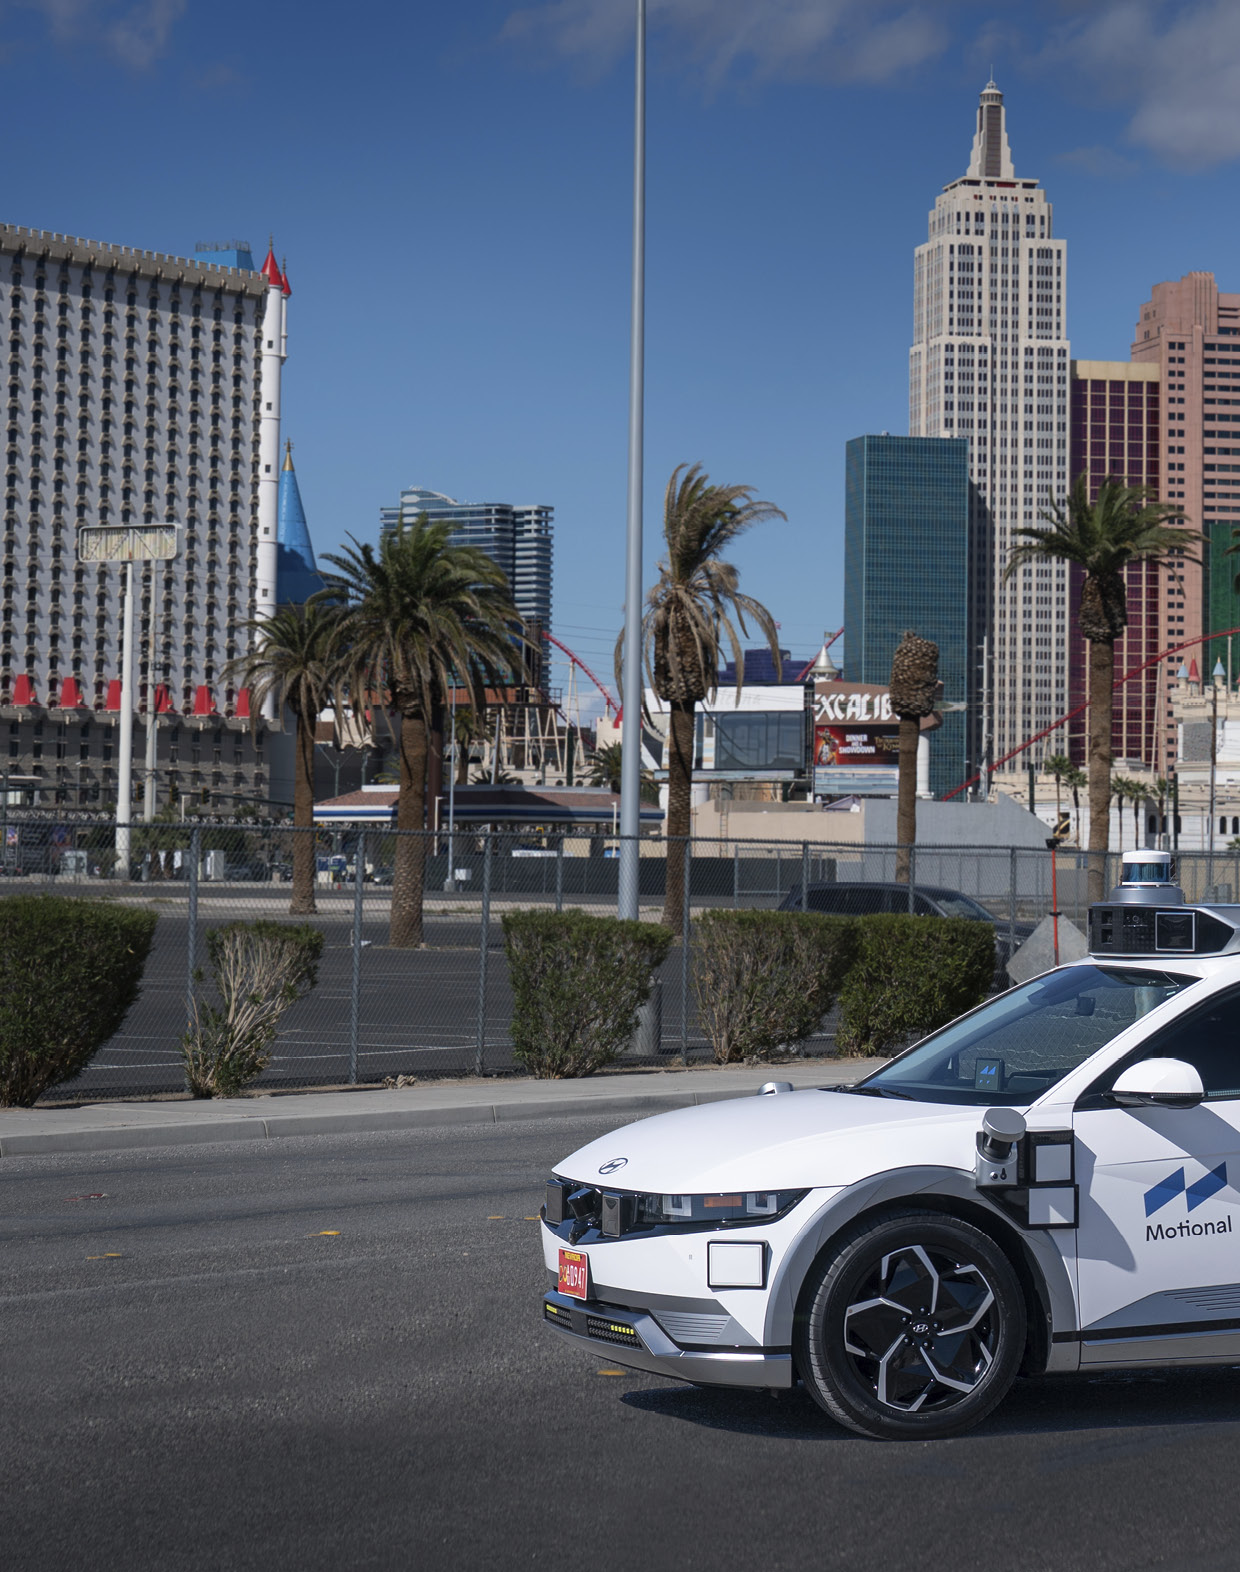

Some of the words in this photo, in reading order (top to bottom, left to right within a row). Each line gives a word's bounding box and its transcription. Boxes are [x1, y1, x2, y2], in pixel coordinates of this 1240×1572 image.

[811, 692, 901, 721] EXCALIB
[838, 746, 876, 754] SHOWDOWN
[1146, 1214, 1233, 1242] Motional
